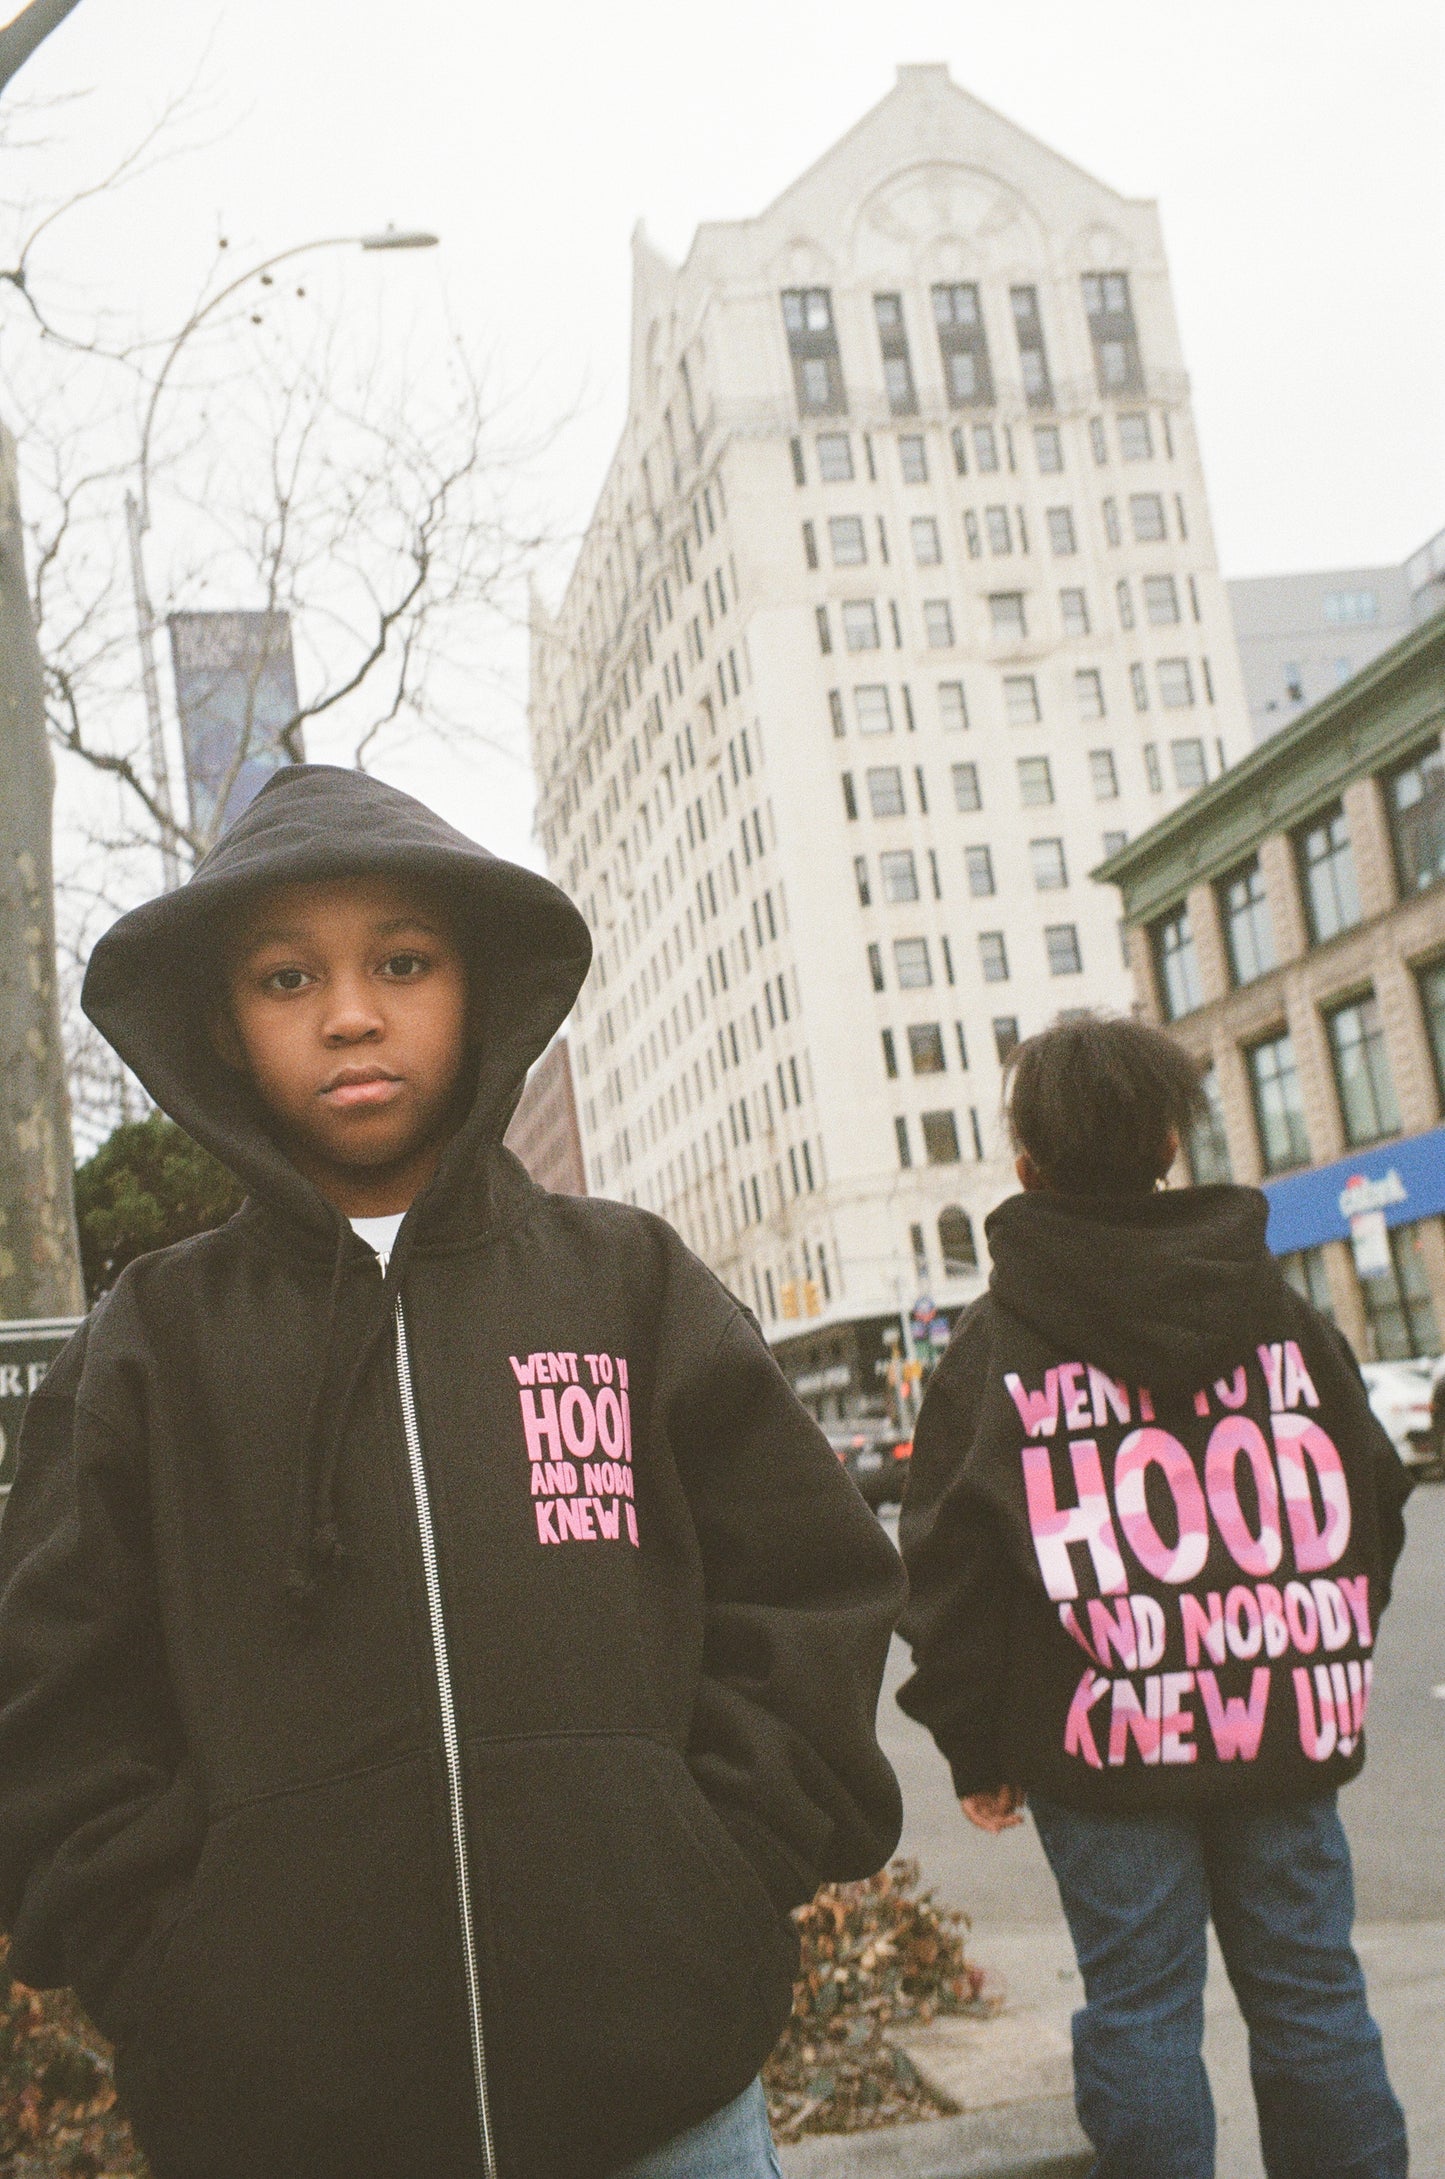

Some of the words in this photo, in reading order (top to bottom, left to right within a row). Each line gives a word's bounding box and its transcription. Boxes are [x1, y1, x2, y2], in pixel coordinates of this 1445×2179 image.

[509, 1352, 579, 1385] WENT
[584, 1353, 613, 1385] TO
[615, 1357, 629, 1391] Y
[1257, 1340, 1320, 1412] YA
[531, 1461, 578, 1495] AND
[583, 1461, 635, 1500] NOBO
[1021, 1413, 1351, 1600] HOOD
[535, 1498, 619, 1544] KNEW
[1179, 1575, 1373, 1667] NOBODY
[1064, 1666, 1271, 1769] KNEW
